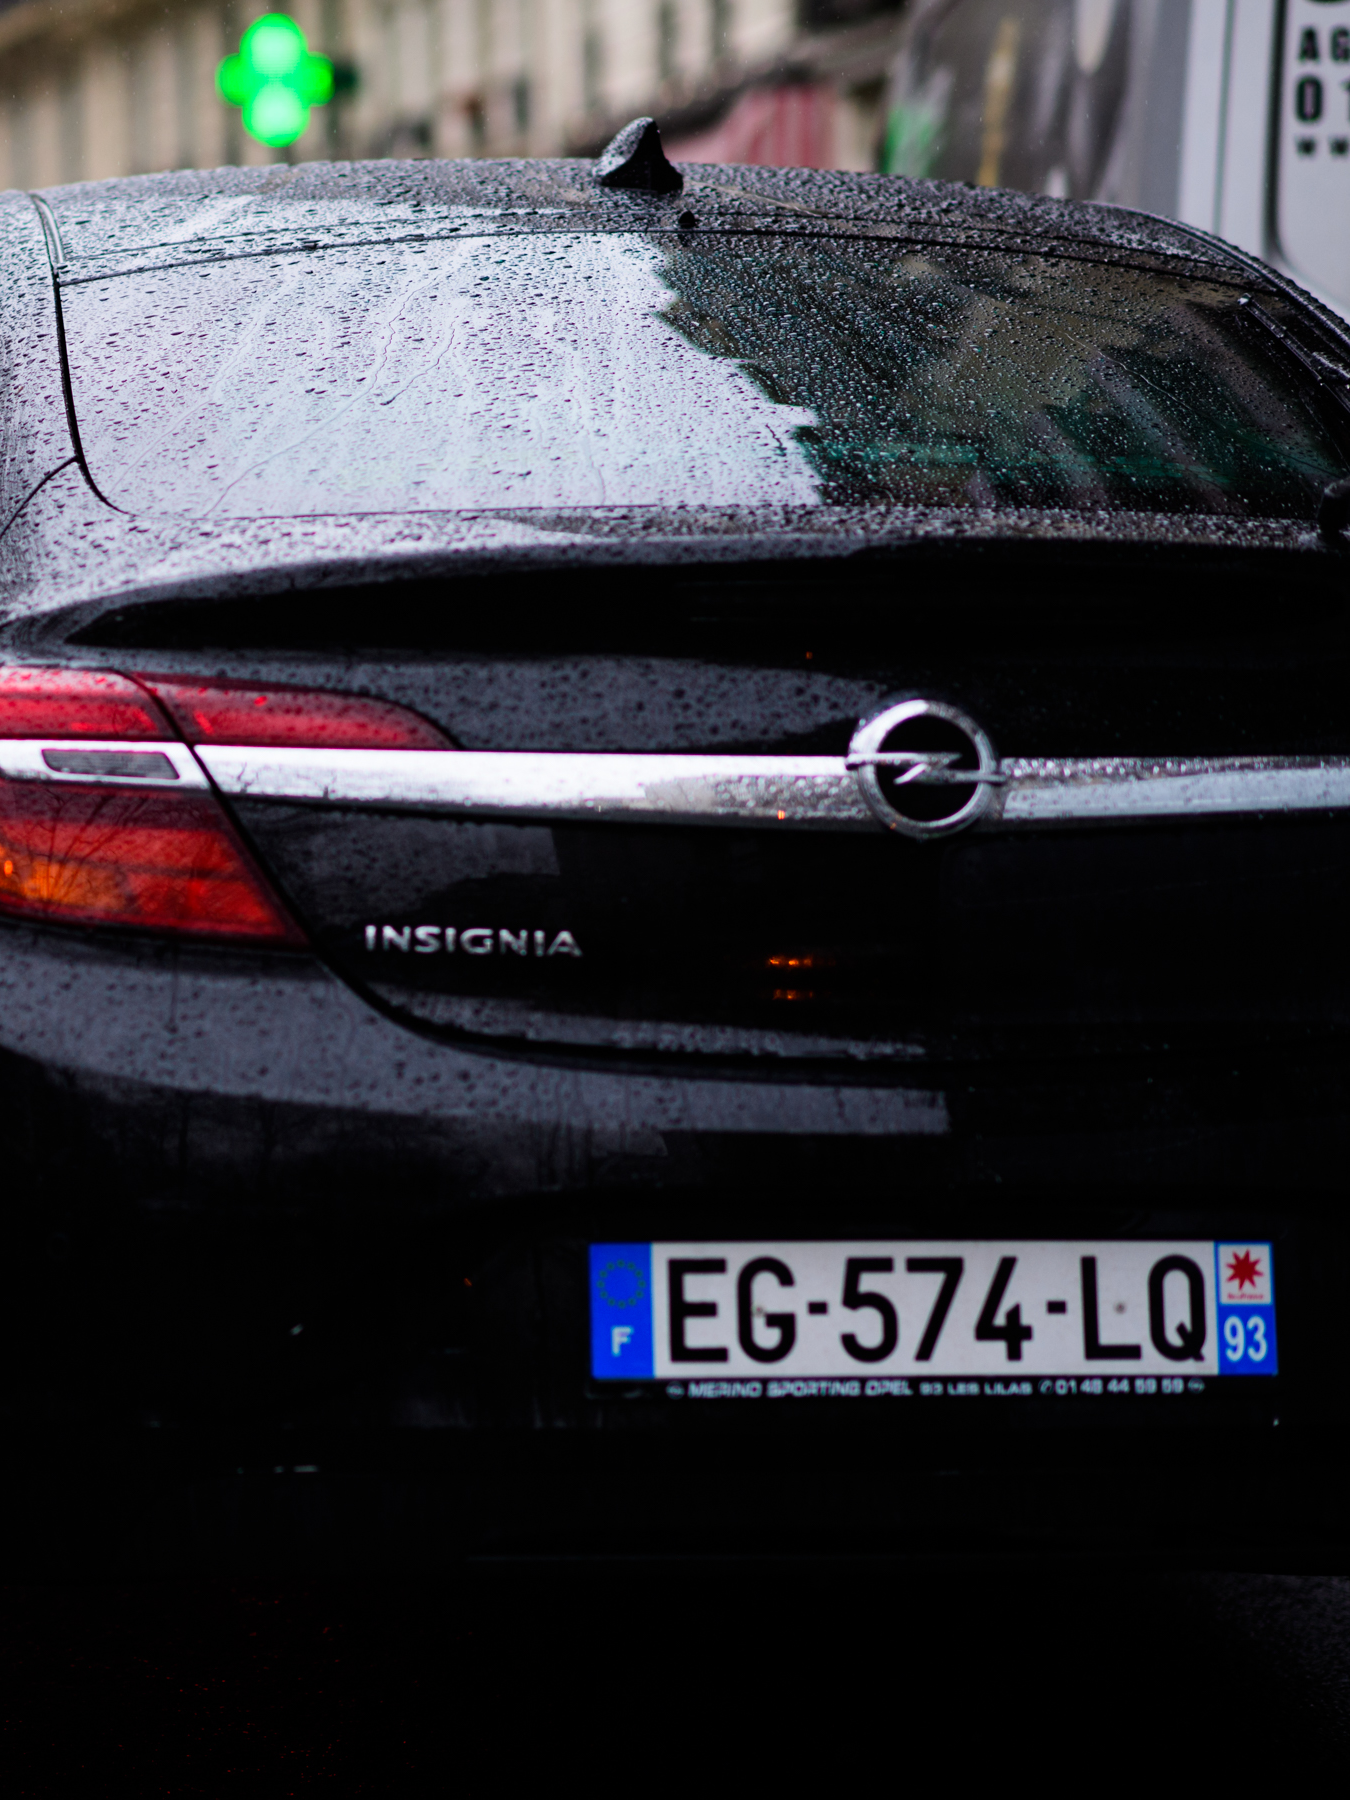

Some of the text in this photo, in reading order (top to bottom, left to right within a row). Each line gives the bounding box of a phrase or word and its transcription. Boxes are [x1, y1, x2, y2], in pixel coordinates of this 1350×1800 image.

[365, 925, 583, 956] INSIGNIA
[667, 1255, 1207, 1363] EG-574-LQ
[611, 1325, 633, 1356] F
[1223, 1315, 1268, 1361] 93
[688, 1381, 762, 1398] MERINO
[767, 1380, 860, 1397] SPORTING
[864, 1380, 913, 1397] OPEL
